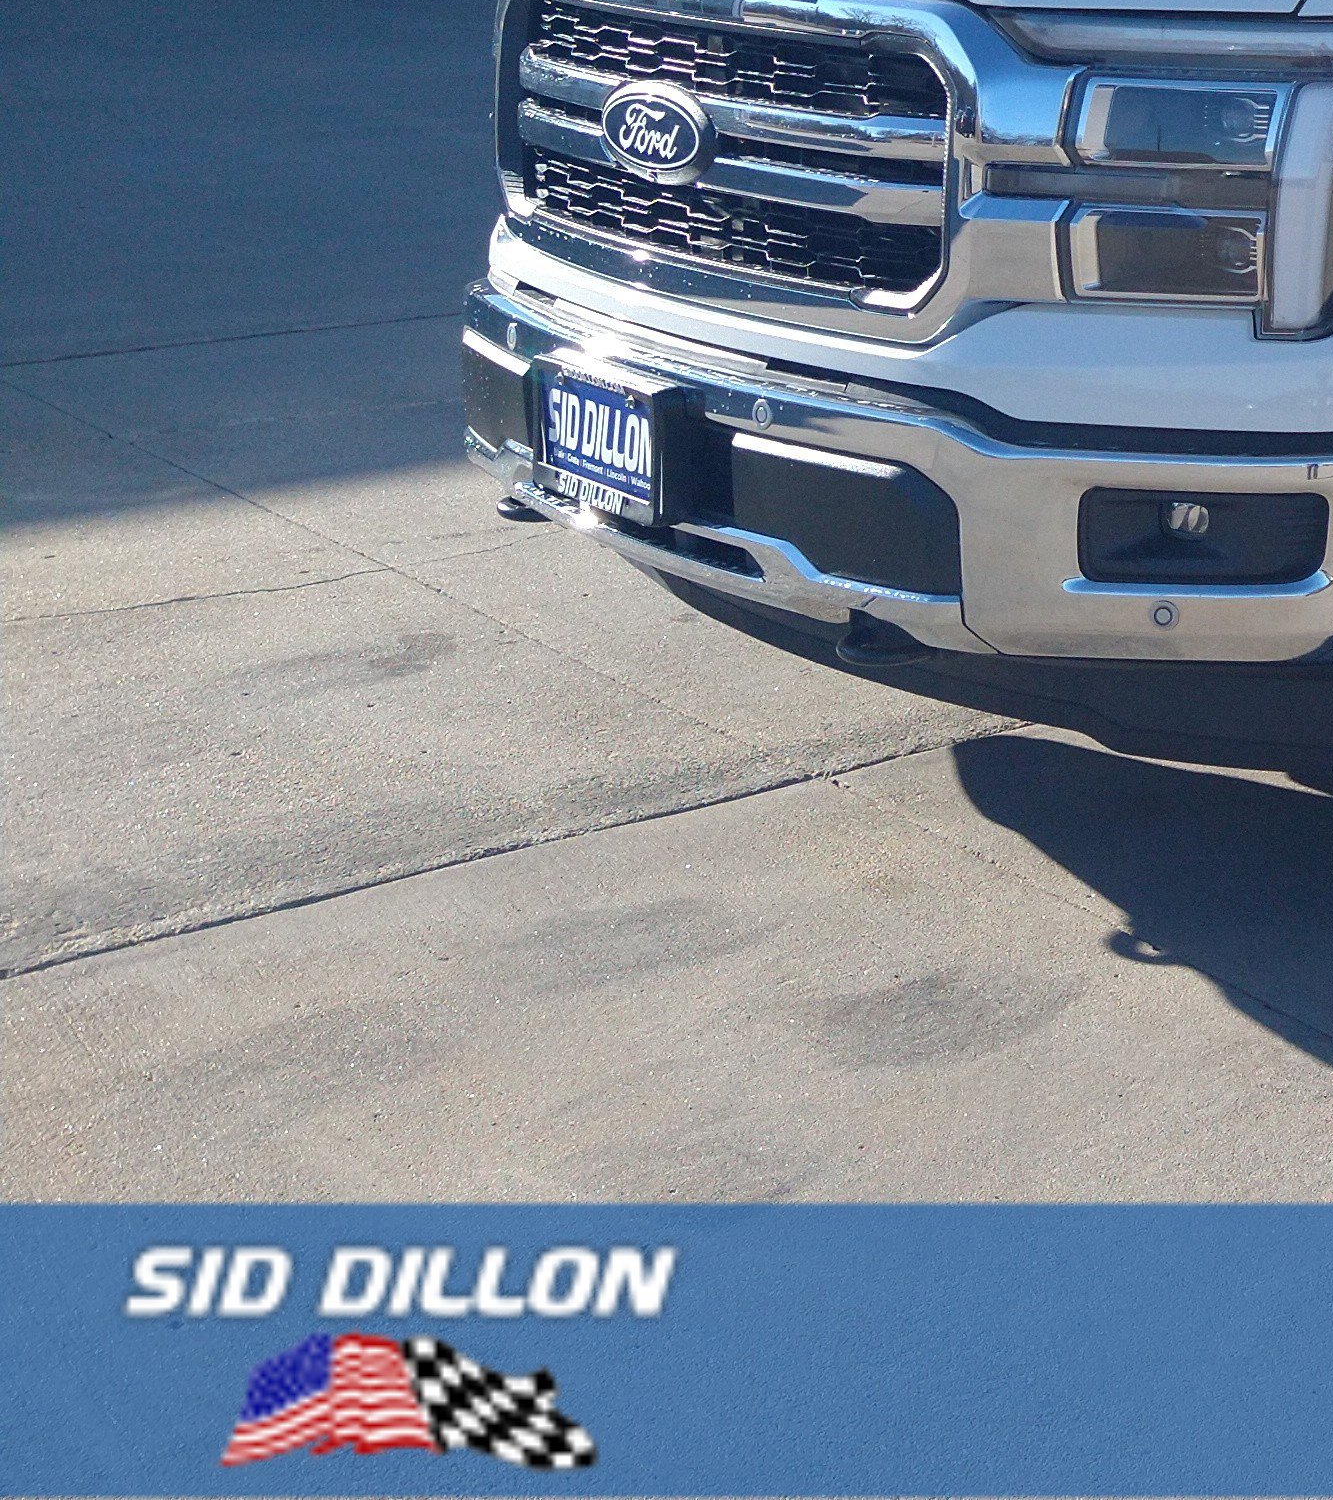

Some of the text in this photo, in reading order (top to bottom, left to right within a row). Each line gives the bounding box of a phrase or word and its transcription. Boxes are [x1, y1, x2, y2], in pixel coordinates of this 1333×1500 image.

[619, 103, 680, 160] Ford
[549, 388, 652, 478] SID DILLON
[558, 471, 623, 515] SID DILLON
[582, 459, 604, 475] Fremont
[606, 468, 627, 483] Lincoln
